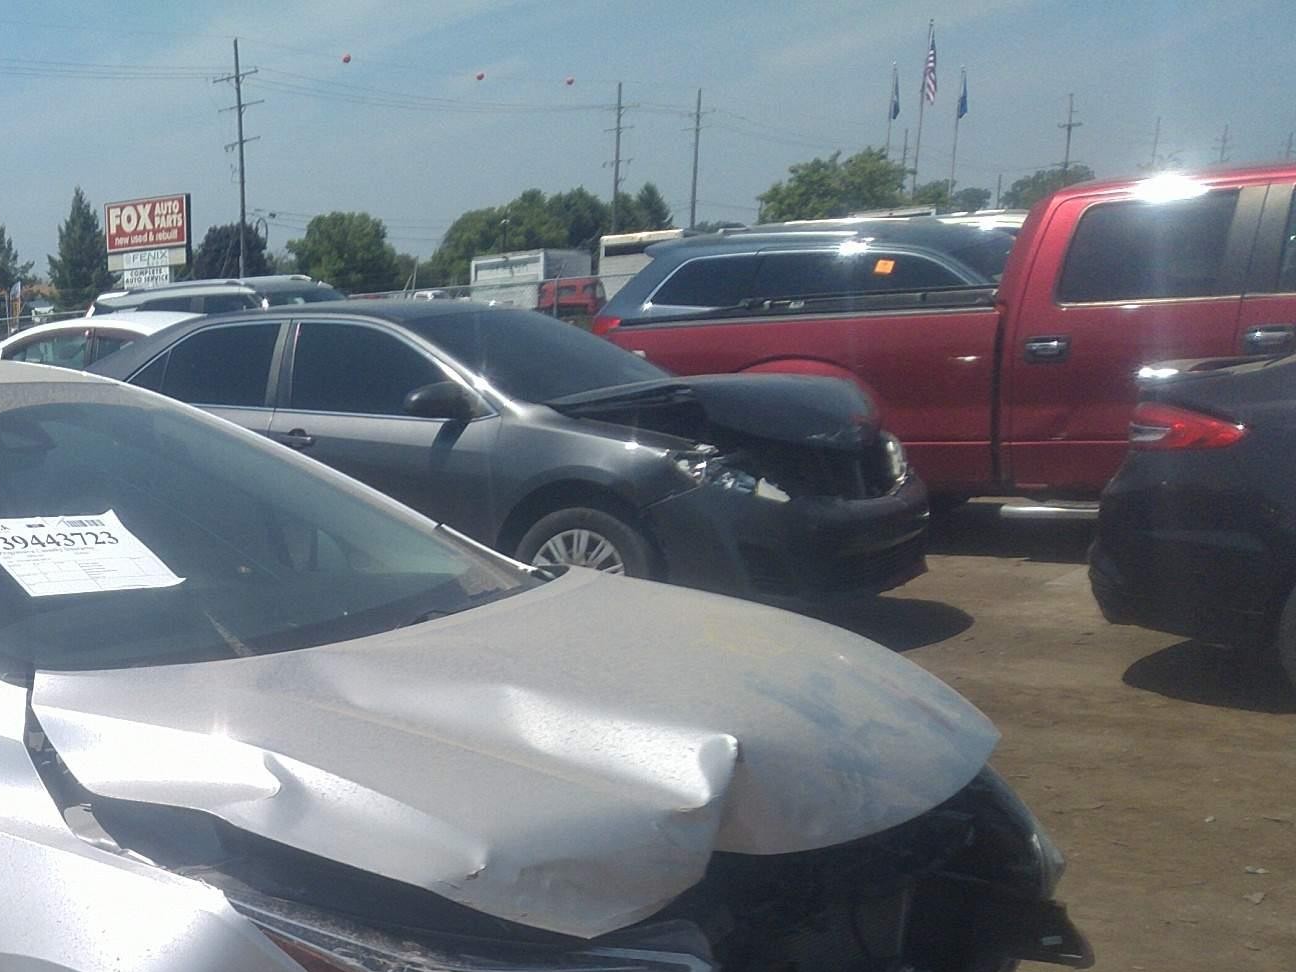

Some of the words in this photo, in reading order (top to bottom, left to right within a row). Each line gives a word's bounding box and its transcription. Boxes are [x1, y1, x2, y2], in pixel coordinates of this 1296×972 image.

[109, 203, 154, 235] FOX
[154, 200, 179, 214] AUTO
[154, 213, 183, 229] PARTS
[114, 235, 129, 246] new
[131, 233, 147, 245] used
[148, 231, 154, 242] &
[155, 229, 178, 242] rebuilt
[132, 250, 167, 263] FENIX
[125, 275, 142, 284] AUTO
[144, 273, 168, 283] SERVICE
[130, 268, 162, 277] COMPLETE
